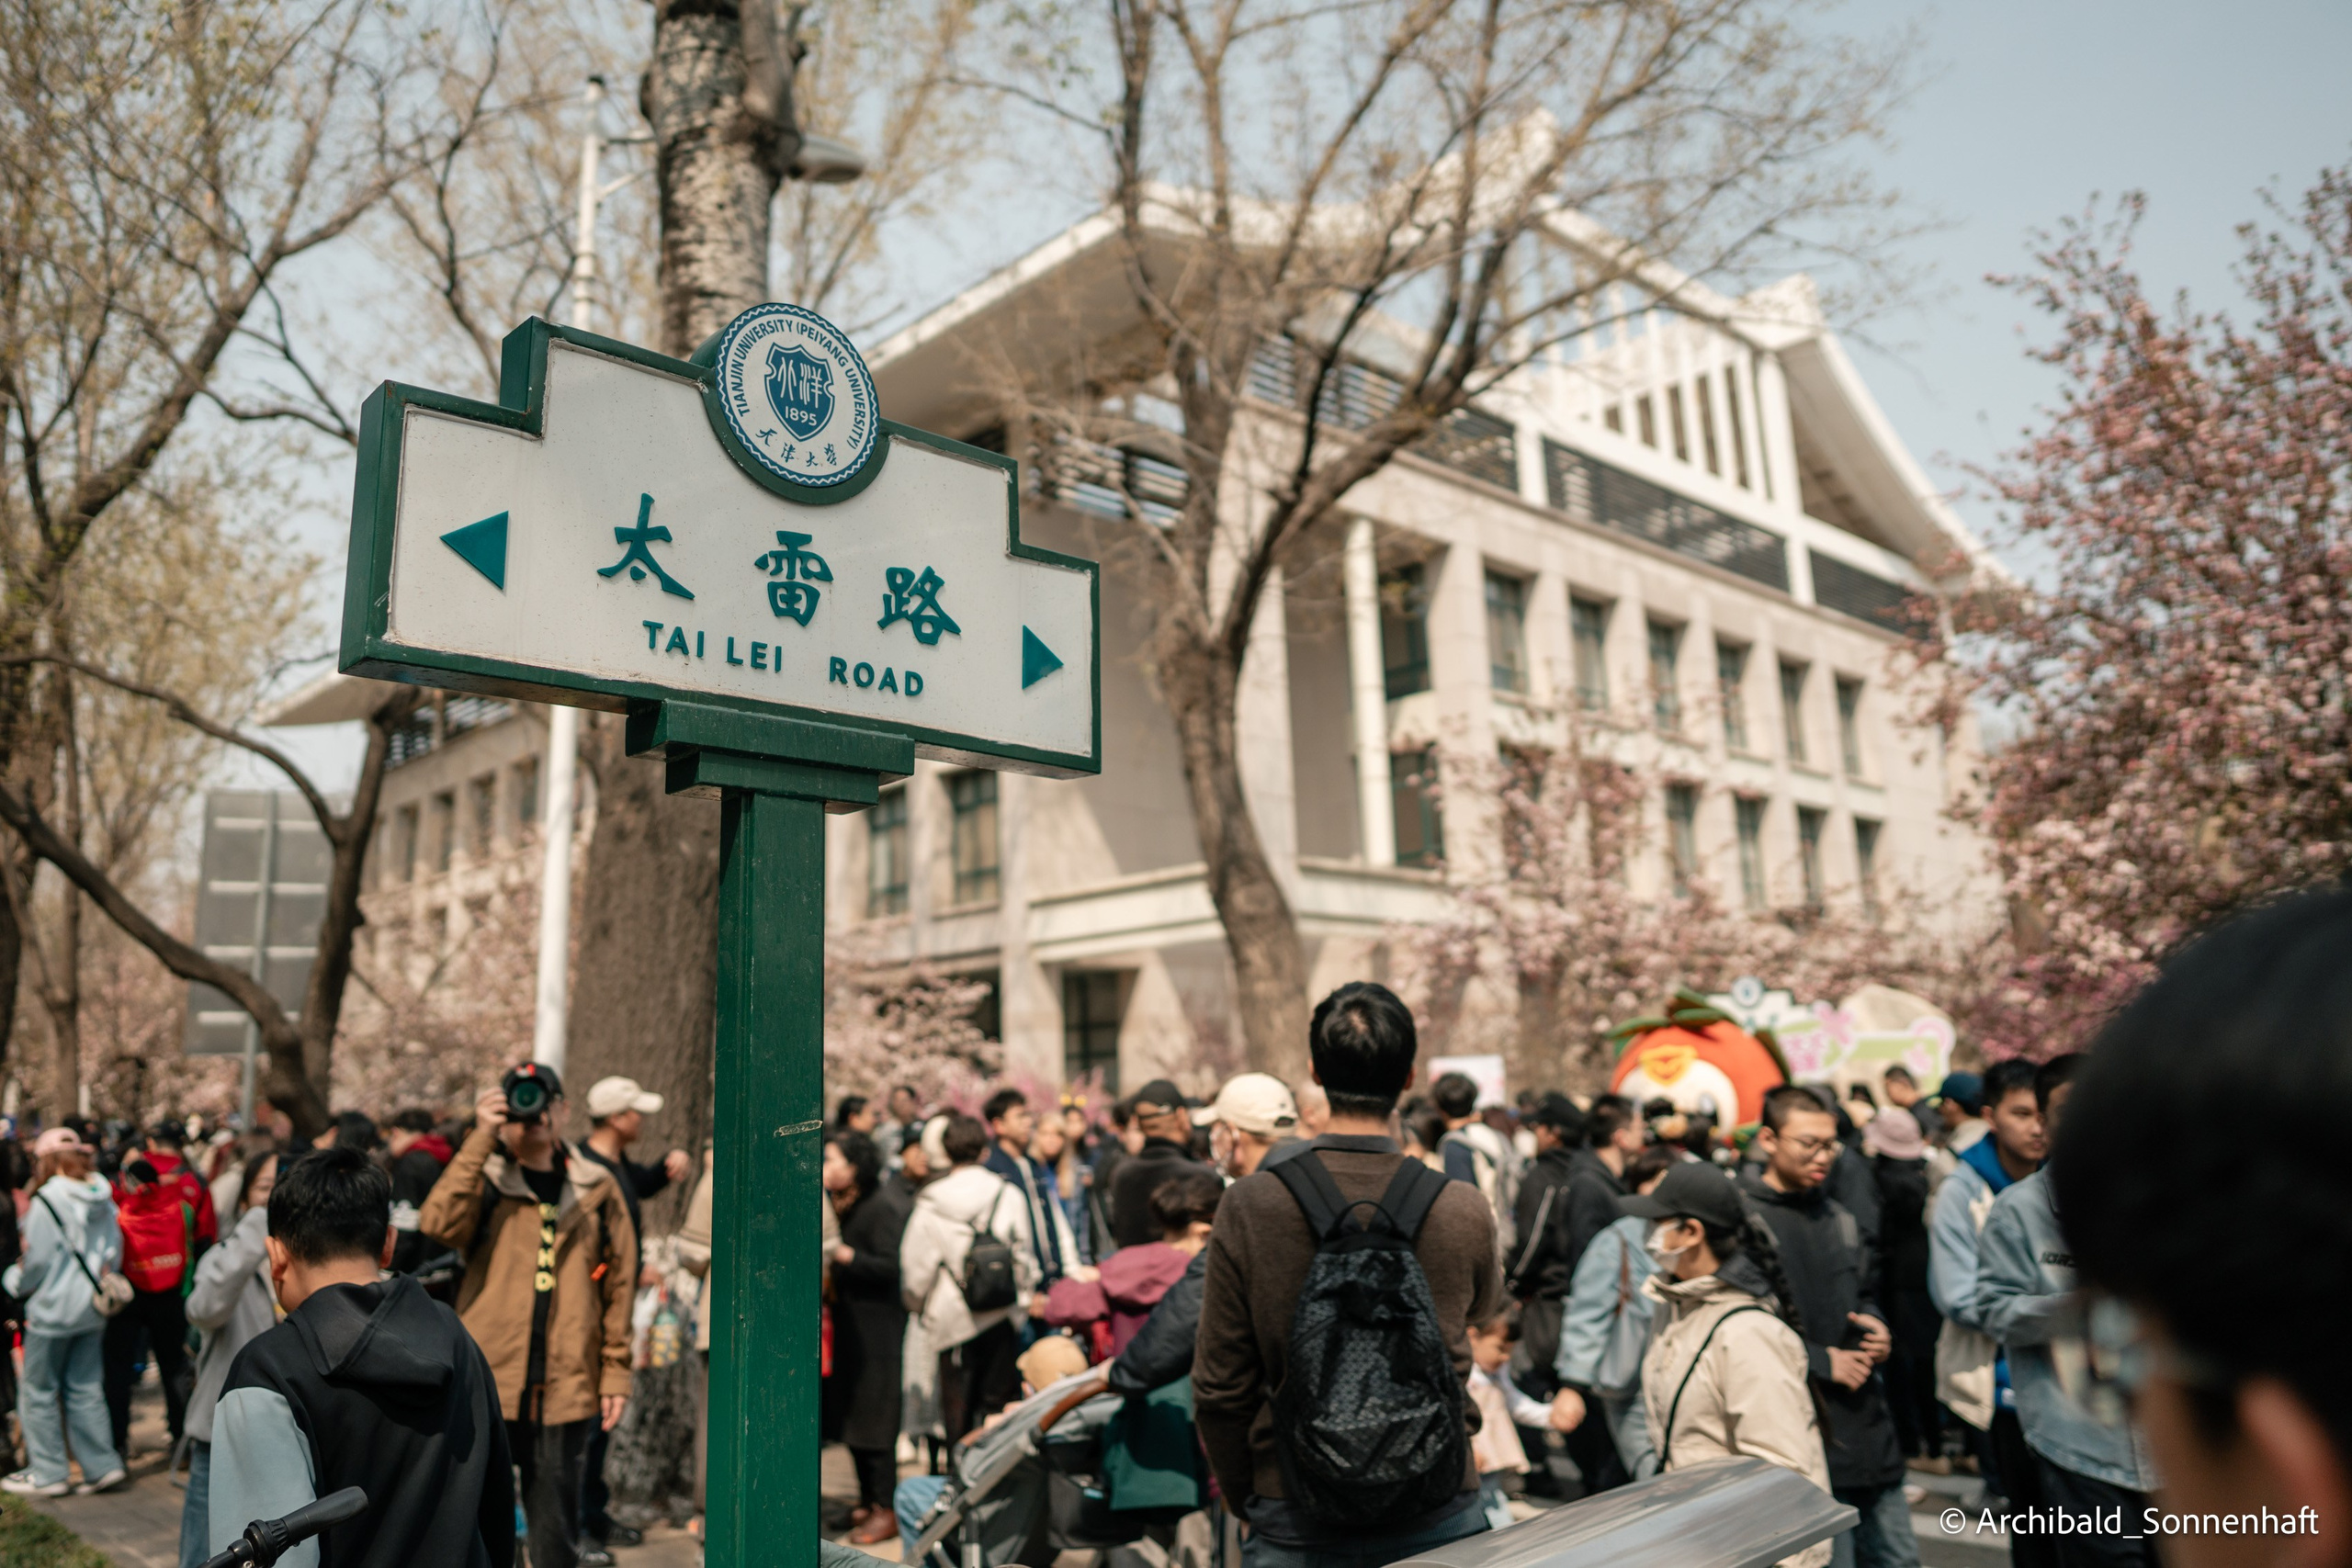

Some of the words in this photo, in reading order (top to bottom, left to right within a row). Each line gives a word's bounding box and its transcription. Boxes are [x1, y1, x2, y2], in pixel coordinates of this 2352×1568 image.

[734, 320, 793, 360] UNIVERSITY
[796, 321, 849, 367] (PEIYANG
[730, 359, 751, 417] TIANJIN
[786, 406, 818, 426] 1895
[844, 367, 866, 450] UNIVERSITY)
[596, 491, 962, 646] 太雷路
[642, 619, 705, 659] TAI
[726, 636, 782, 673] LEI
[829, 656, 925, 697] ROAD
